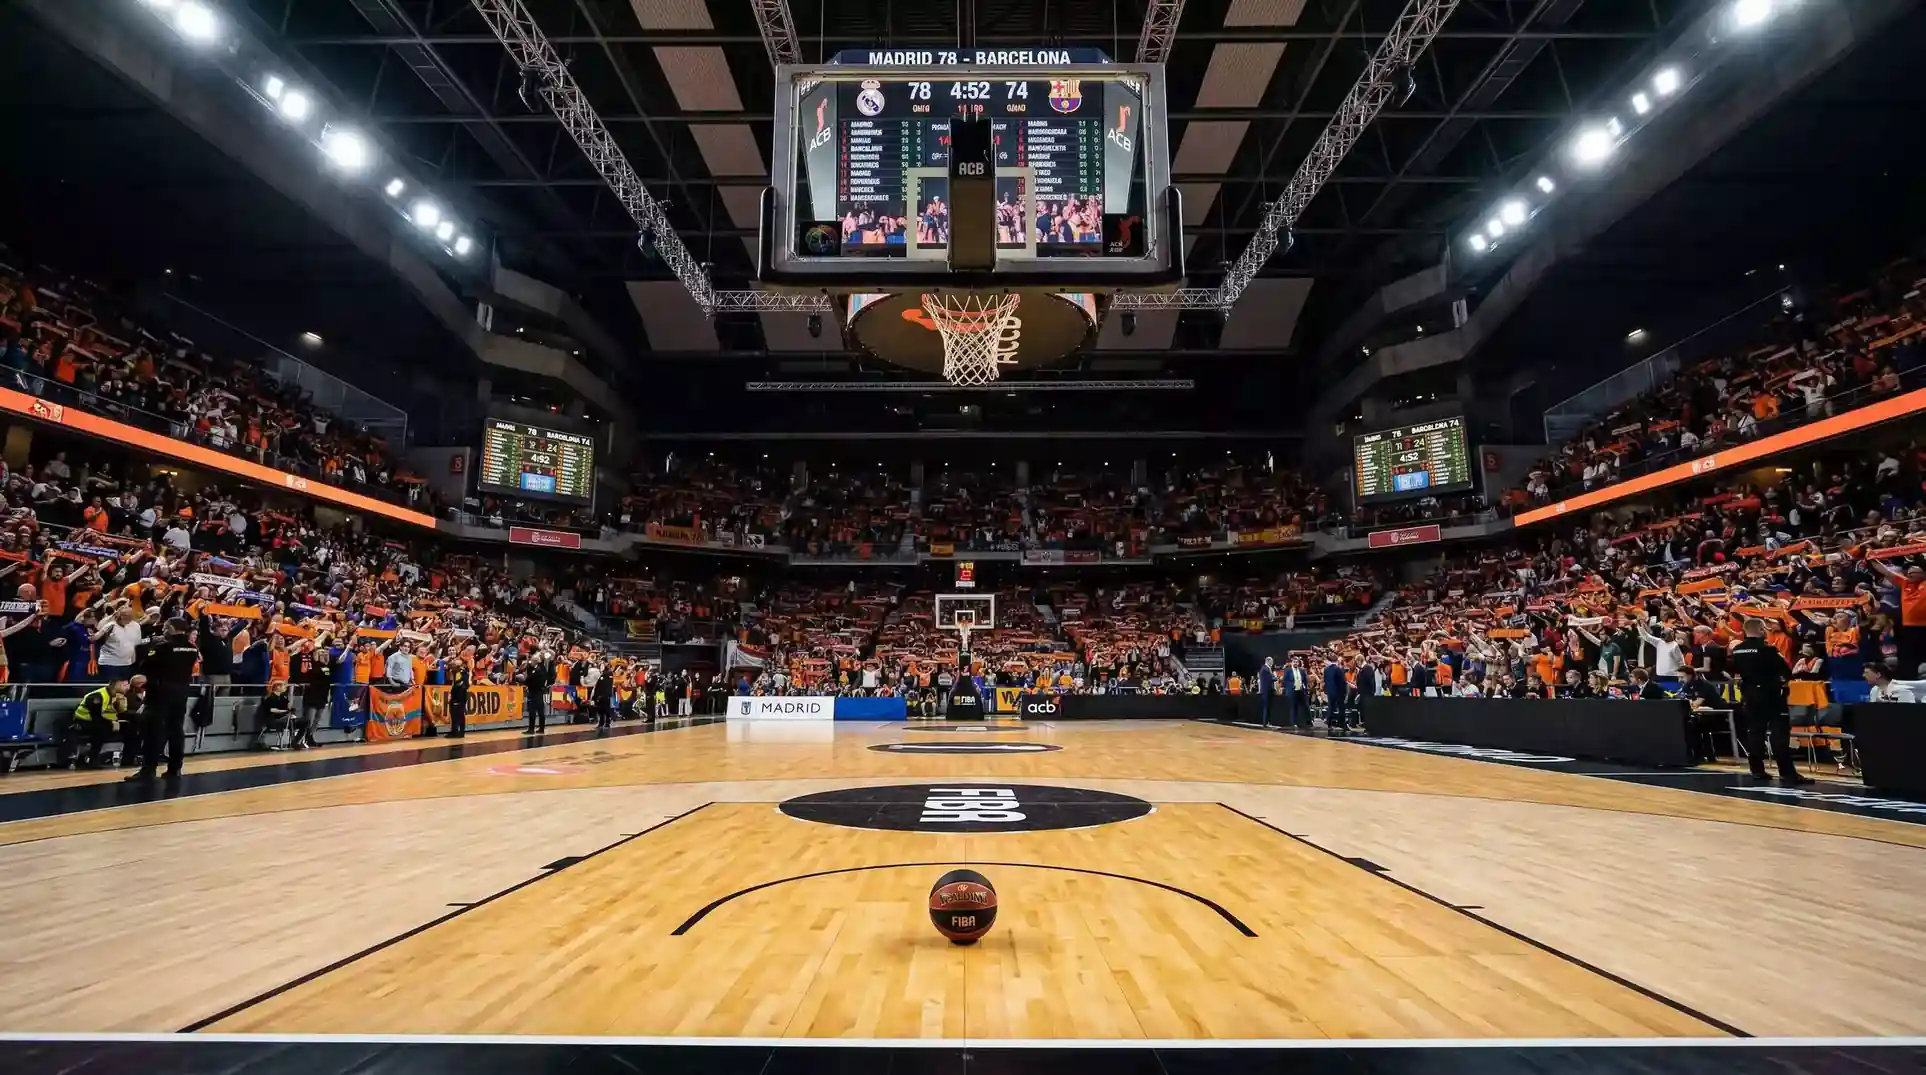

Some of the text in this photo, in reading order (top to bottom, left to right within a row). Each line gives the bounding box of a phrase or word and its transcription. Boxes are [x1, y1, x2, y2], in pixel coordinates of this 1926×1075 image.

[869, 51, 933, 65] MADRID
[938, 51, 958, 65] 78
[975, 50, 1072, 65] BARCELONA
[908, 81, 932, 100] 78
[950, 81, 991, 100] 4:52
[1005, 81, 1029, 100] 74
[809, 126, 832, 152] ACB
[1107, 128, 1131, 152] ACB
[958, 161, 985, 176] ACB
[443, 691, 500, 716] DRID
[761, 702, 821, 714] MADRID
[1027, 700, 1056, 713] acb
[919, 788, 1027, 823] FIBA
[951, 915, 976, 928] FIBA
